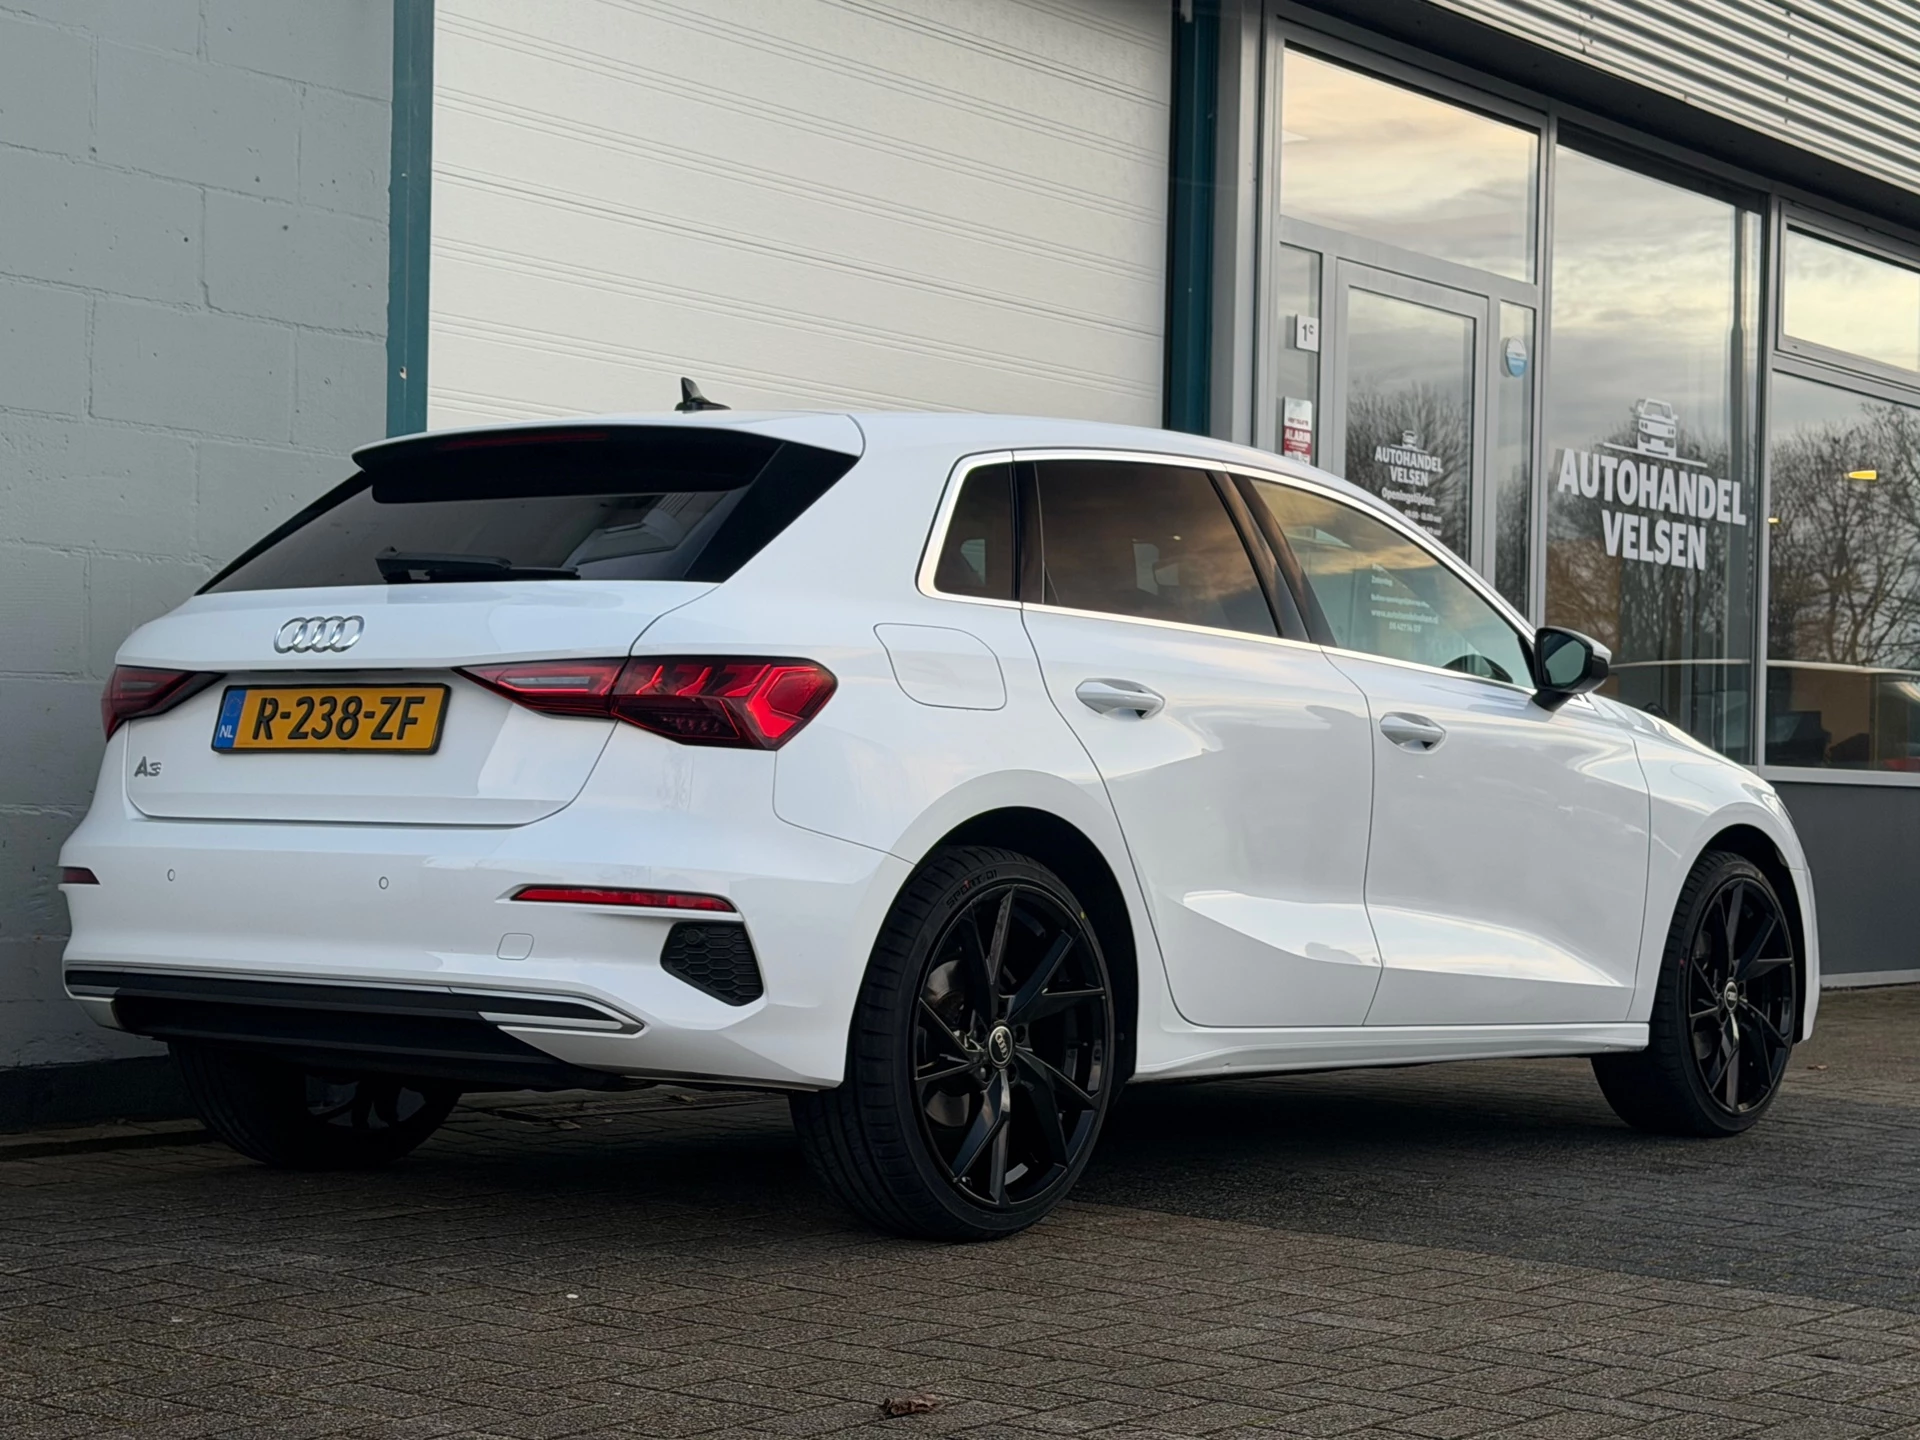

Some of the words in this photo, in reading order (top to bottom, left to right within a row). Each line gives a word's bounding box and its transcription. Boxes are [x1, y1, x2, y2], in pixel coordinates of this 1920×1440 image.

[1374, 446, 1444, 474] AUTOHANDEL
[1389, 465, 1429, 488] VELSEN
[1557, 448, 1747, 526] AUTOHANDEL
[1601, 509, 1707, 571] VELSEN
[219, 725, 234, 739] NL
[252, 695, 426, 741] R-238-ZF
[133, 755, 162, 778] A3
